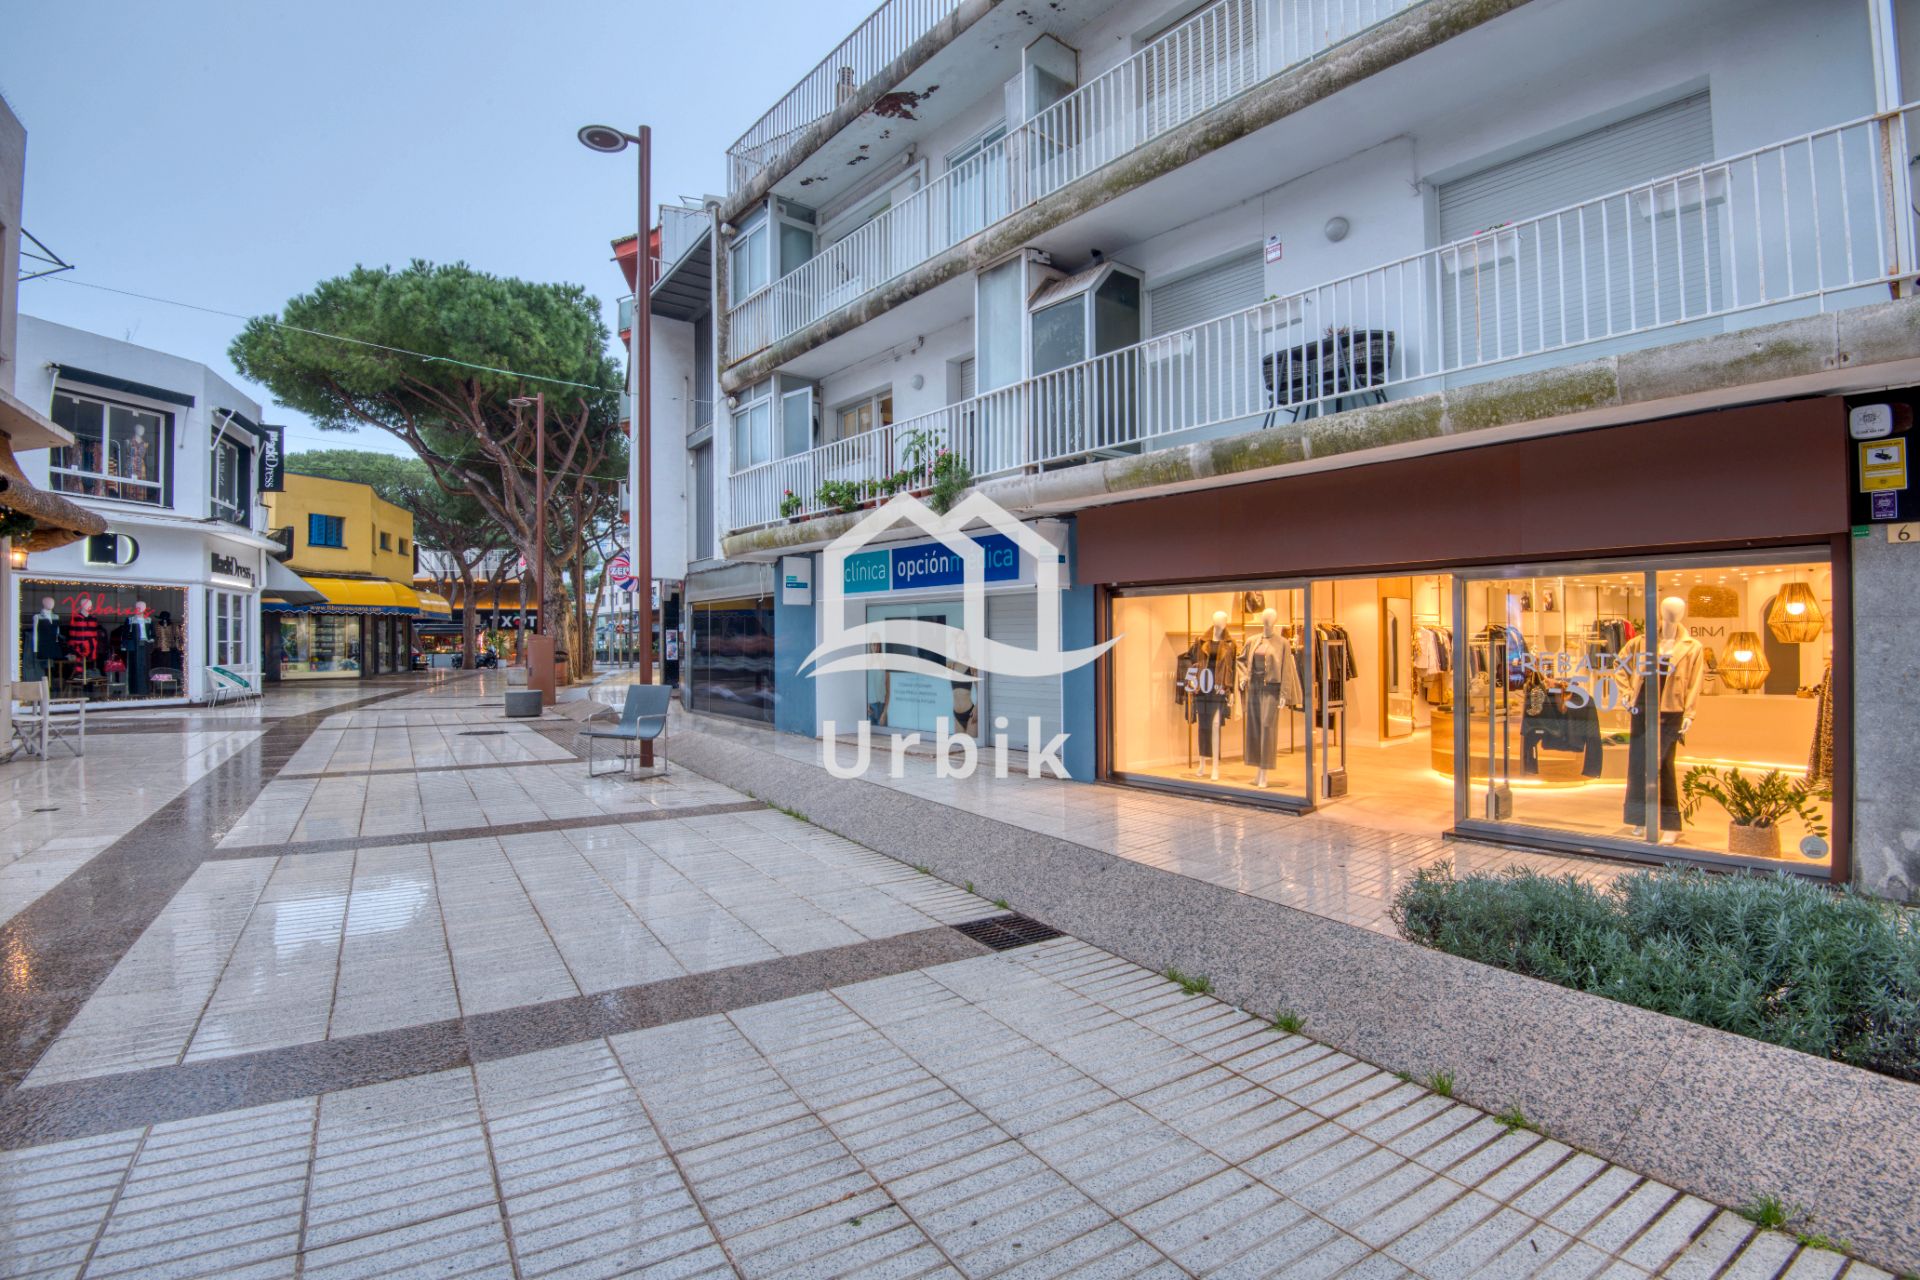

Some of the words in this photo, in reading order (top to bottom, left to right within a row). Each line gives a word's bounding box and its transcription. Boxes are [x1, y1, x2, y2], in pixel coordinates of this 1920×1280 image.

[1898, 525, 1910, 541] 6
[844, 560, 886, 583] clínica
[1521, 652, 1676, 676] REBAIXES
